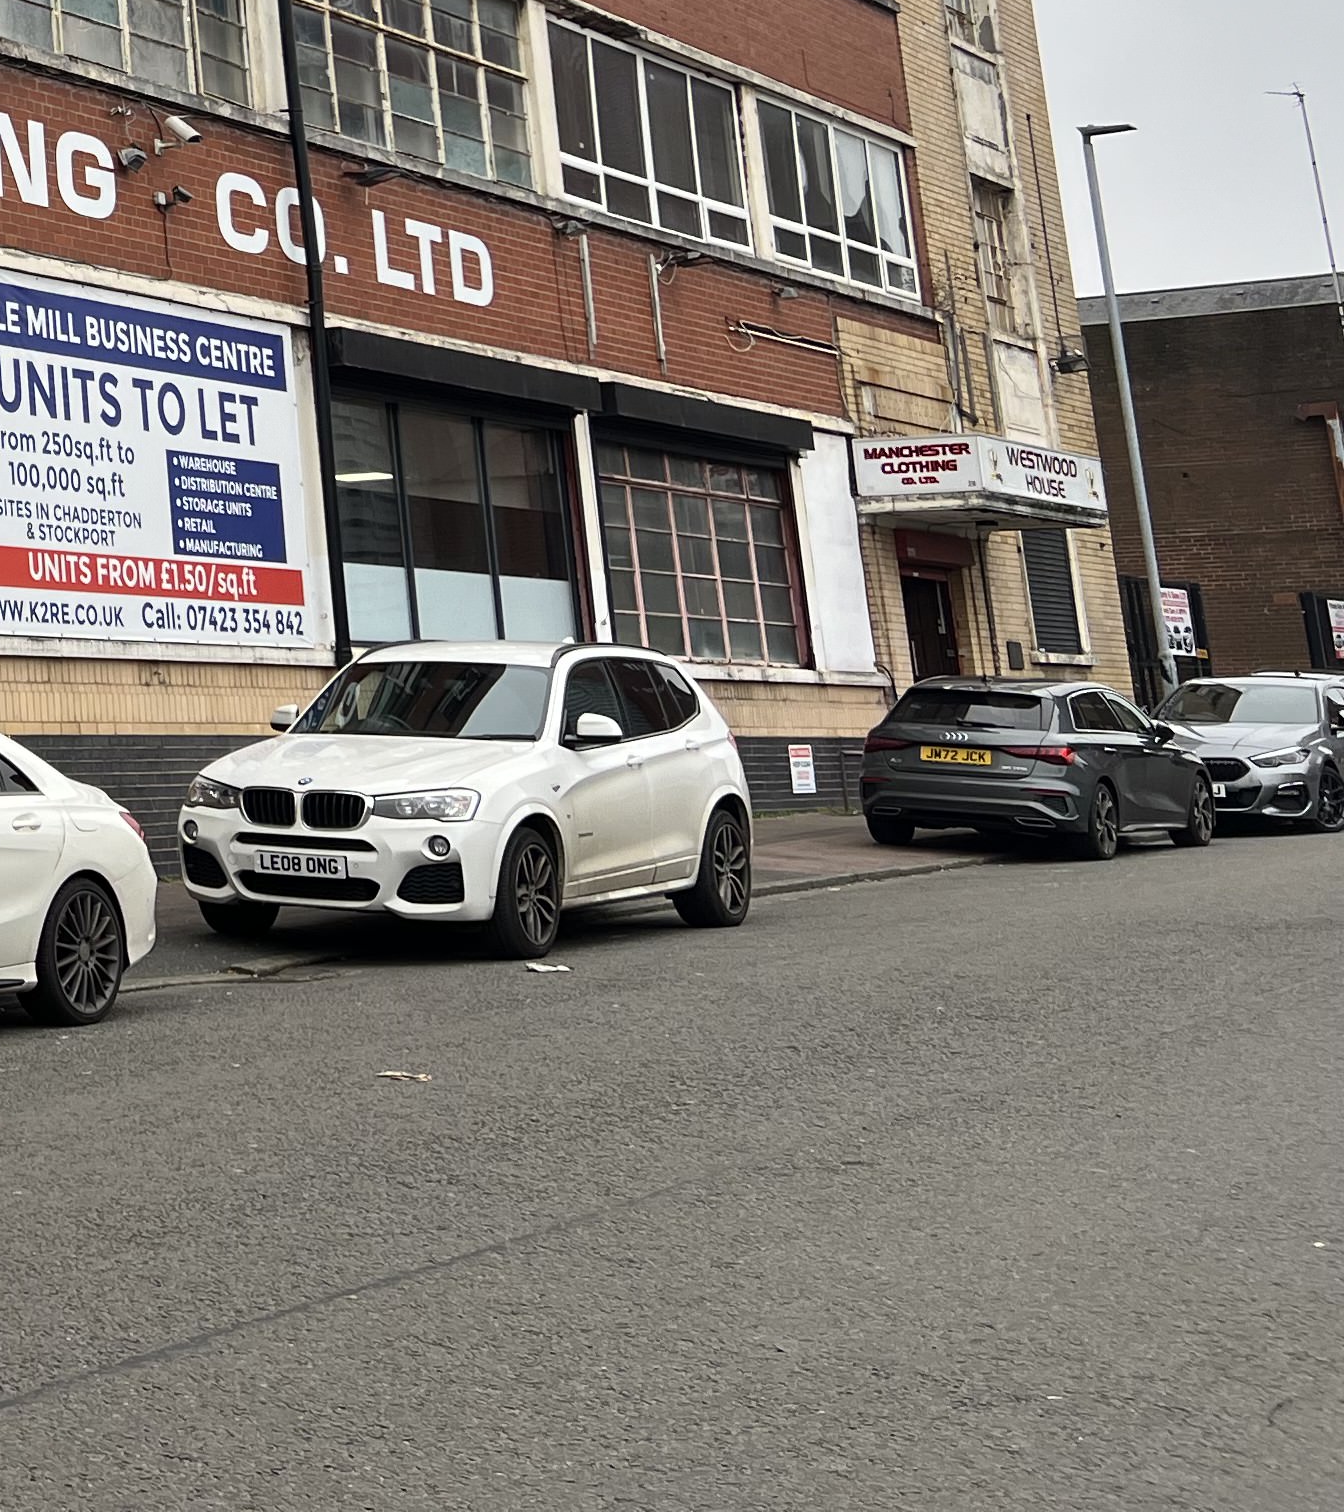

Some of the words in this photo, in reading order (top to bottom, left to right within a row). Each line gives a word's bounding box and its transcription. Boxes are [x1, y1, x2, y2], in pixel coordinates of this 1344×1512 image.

[215, 172, 349, 275] CO.
[371, 208, 494, 307] LTD
[26, 305, 81, 345] MILL
[85, 315, 192, 363] BUSINESS
[195, 336, 276, 378] CENTRE
[132, 377, 186, 436] TO
[197, 387, 259, 446] LET
[41, 430, 114, 466] 250sq.ft
[117, 440, 135, 465] to
[864, 443, 971, 460] MANCHESTER
[178, 454, 237, 476] WAREHOUSE
[881, 459, 958, 475] CLOTHING
[1006, 446, 1078, 479] WESTWOOD
[8, 461, 81, 492] 100,000
[86, 472, 126, 502] sq.ft
[180, 475, 243, 497] DISTRIBUTION
[243, 482, 278, 500] CENTRE
[1025, 473, 1067, 499] HOUSE
[35, 502, 50, 521] IN
[53, 504, 142, 529] CHADDERTON
[182, 496, 225, 515] STORAGE
[226, 500, 253, 517] UNITS
[26, 522, 35, 540] &
[38, 523, 116, 547] STOCKPORT
[183, 517, 217, 534] RETAIL
[185, 537, 264, 558] MANUFACTURING
[28, 551, 92, 585] UNITS
[96, 557, 156, 589] FROM
[160, 560, 258, 601] £1.50/sq.ft
[141, 601, 182, 630] Call:
[186, 604, 238, 633] 07423
[242, 607, 271, 635] 354
[275, 609, 304, 636] 842
[962, 750, 987, 763] JCK
[305, 856, 339, 875] ONG
